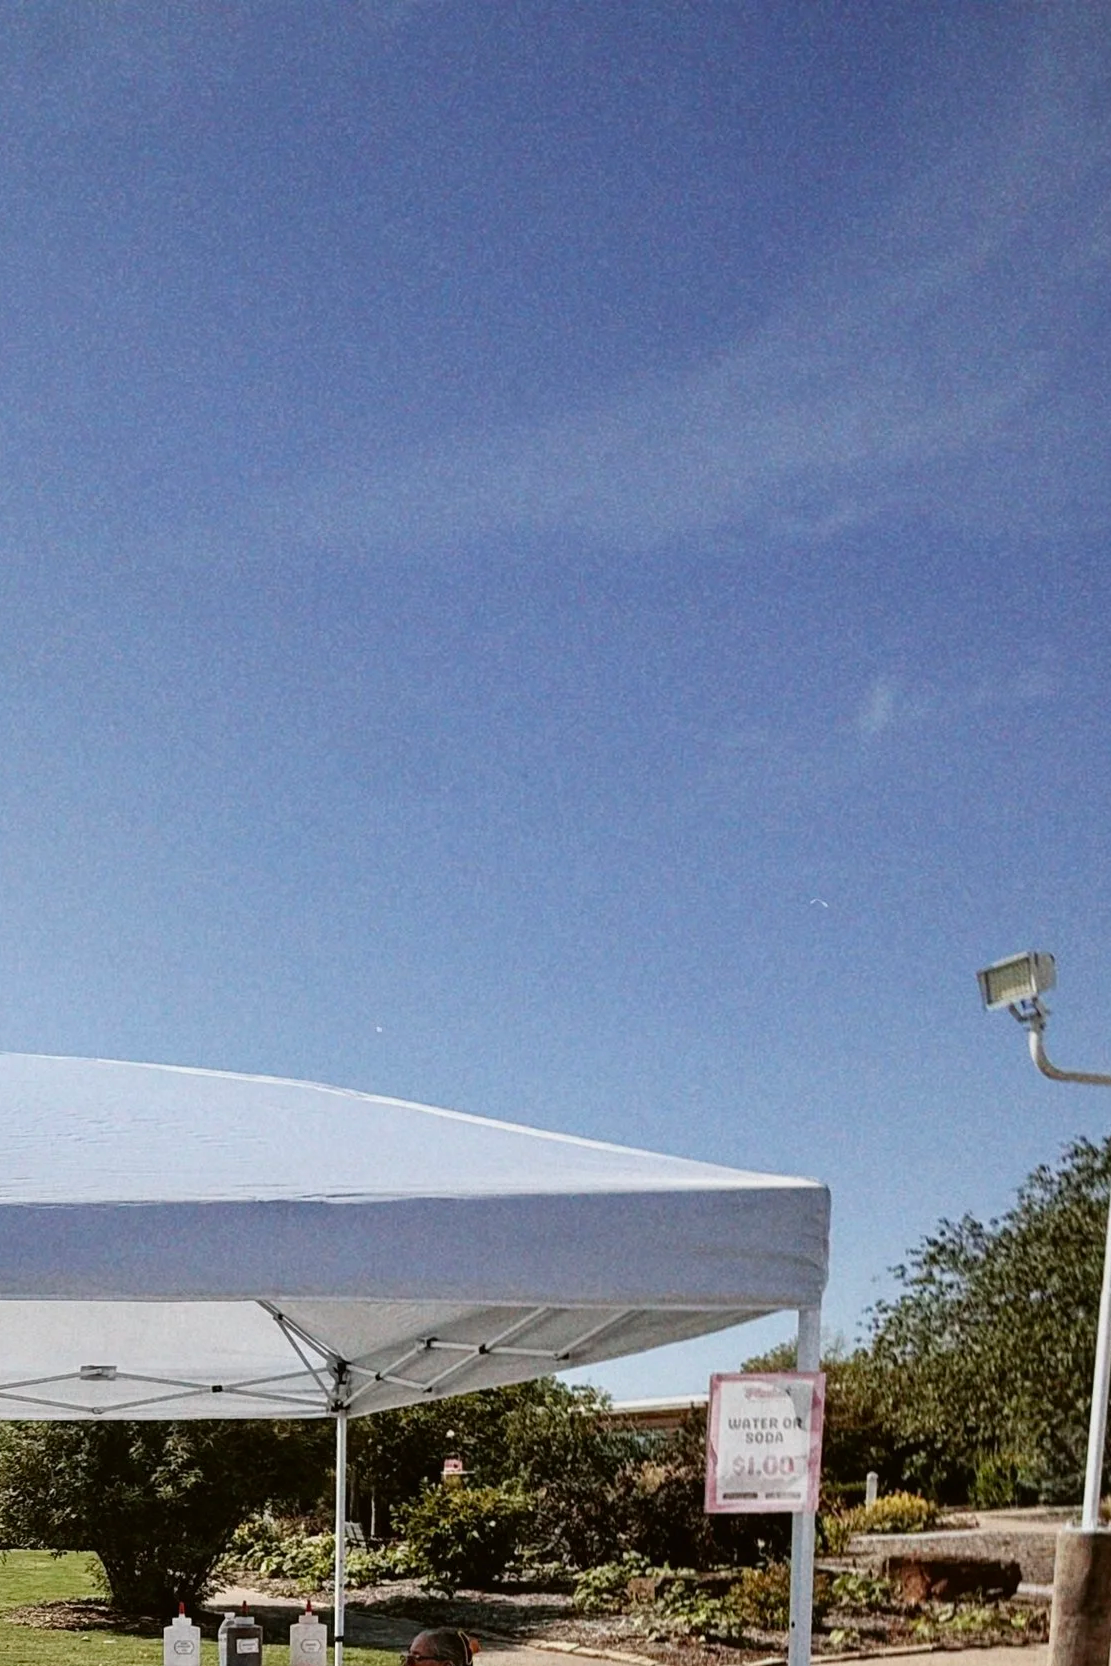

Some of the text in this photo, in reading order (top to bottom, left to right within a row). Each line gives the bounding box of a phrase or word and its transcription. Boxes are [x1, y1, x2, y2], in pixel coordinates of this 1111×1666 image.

[728, 1416, 803, 1430] WATER OR
[745, 1431, 784, 1445] SODA
[732, 1454, 794, 1477] $1.00
